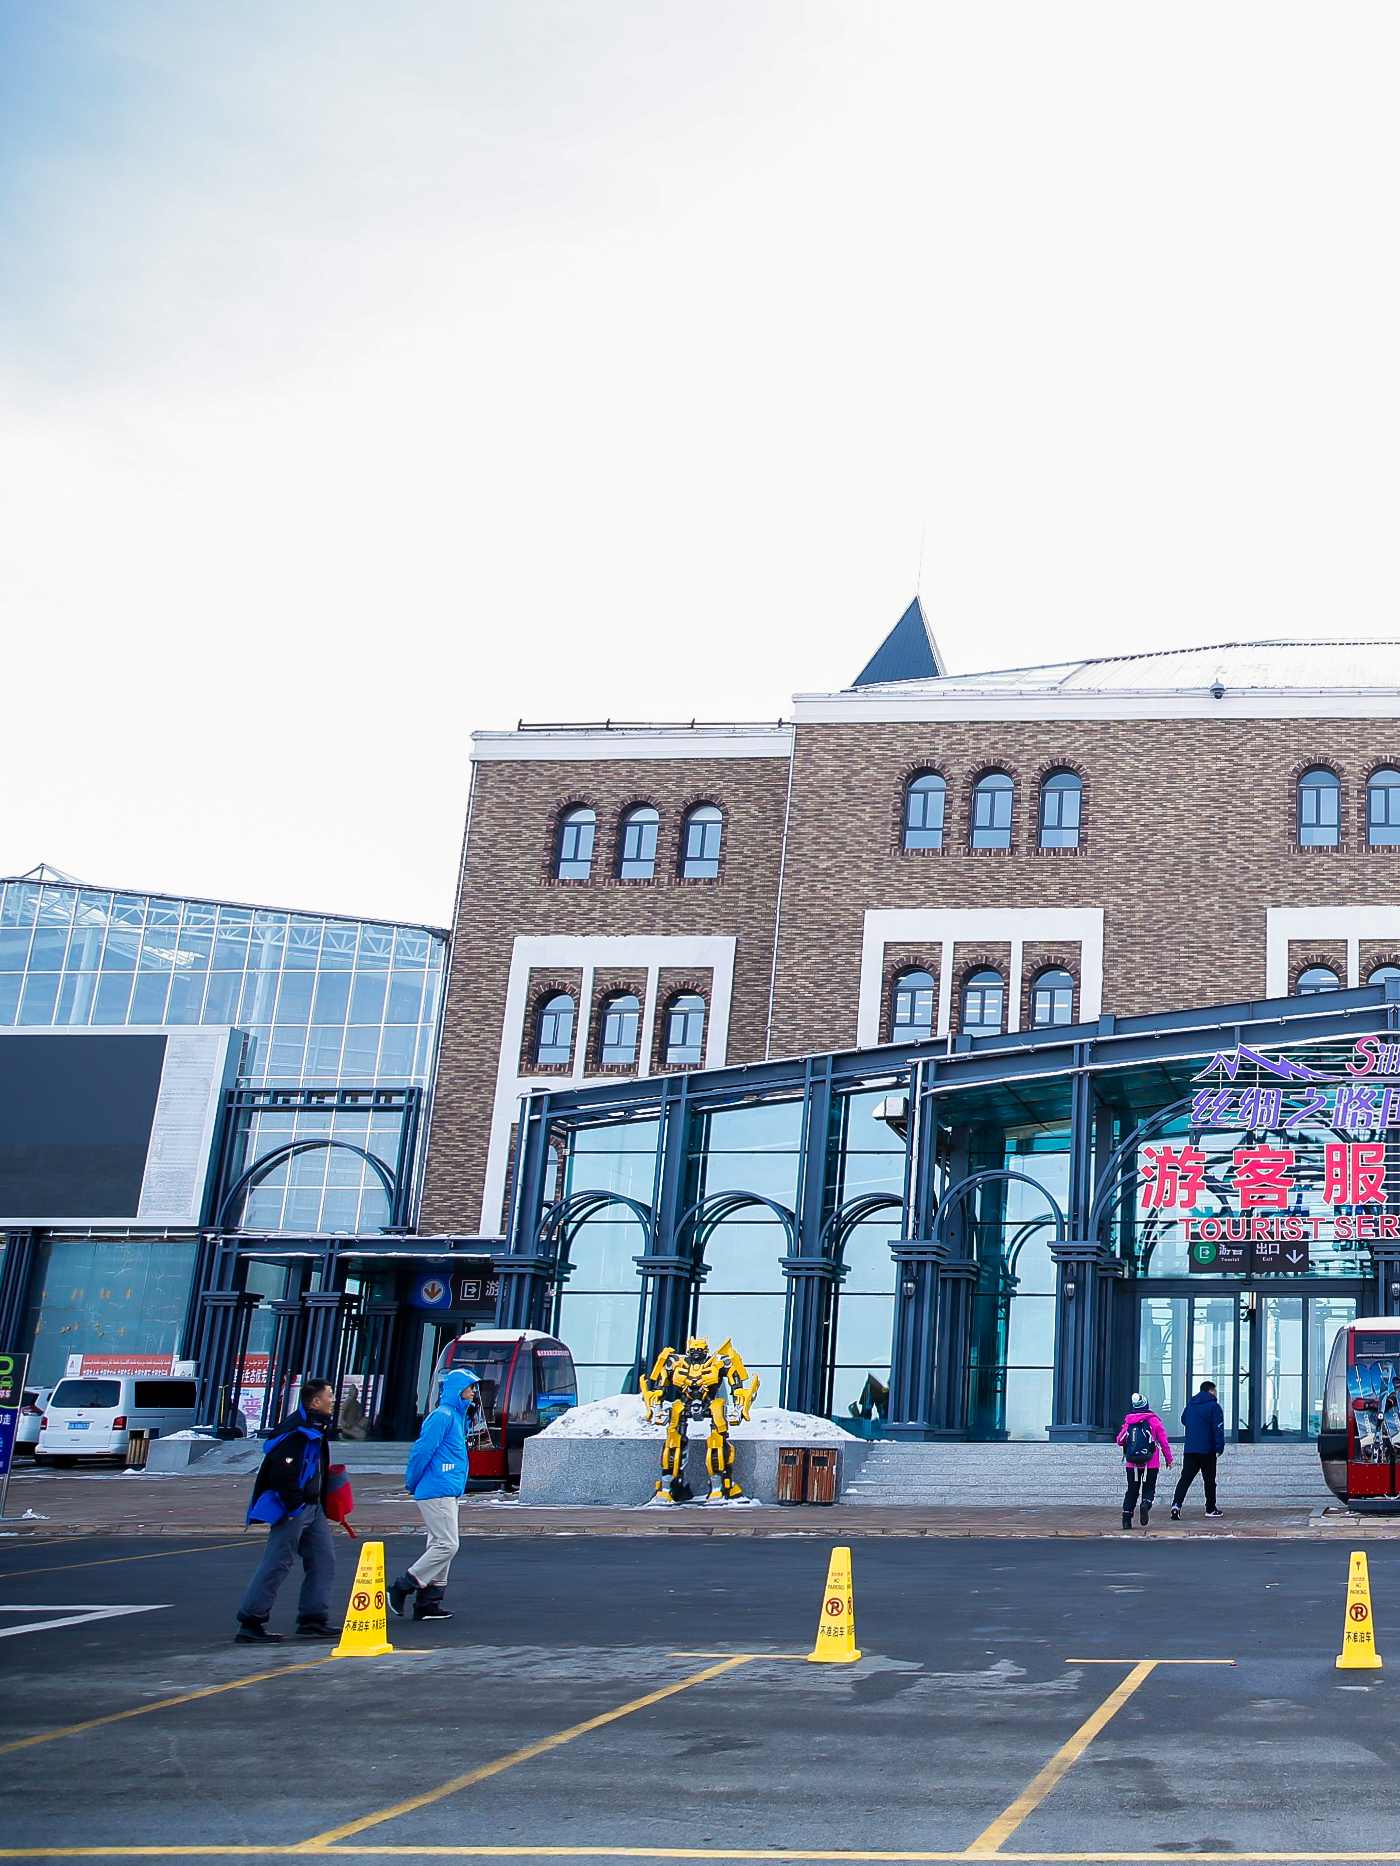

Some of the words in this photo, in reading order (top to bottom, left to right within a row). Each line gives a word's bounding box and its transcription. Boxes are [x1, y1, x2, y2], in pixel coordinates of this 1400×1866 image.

[1178, 1217, 1326, 1241] TOURIST
[1256, 1242, 1280, 1255] 出口
[345, 1620, 370, 1632] 不准泊车
[820, 1625, 845, 1638] 不准泊车
[1345, 1631, 1371, 1643] 不准泊车
